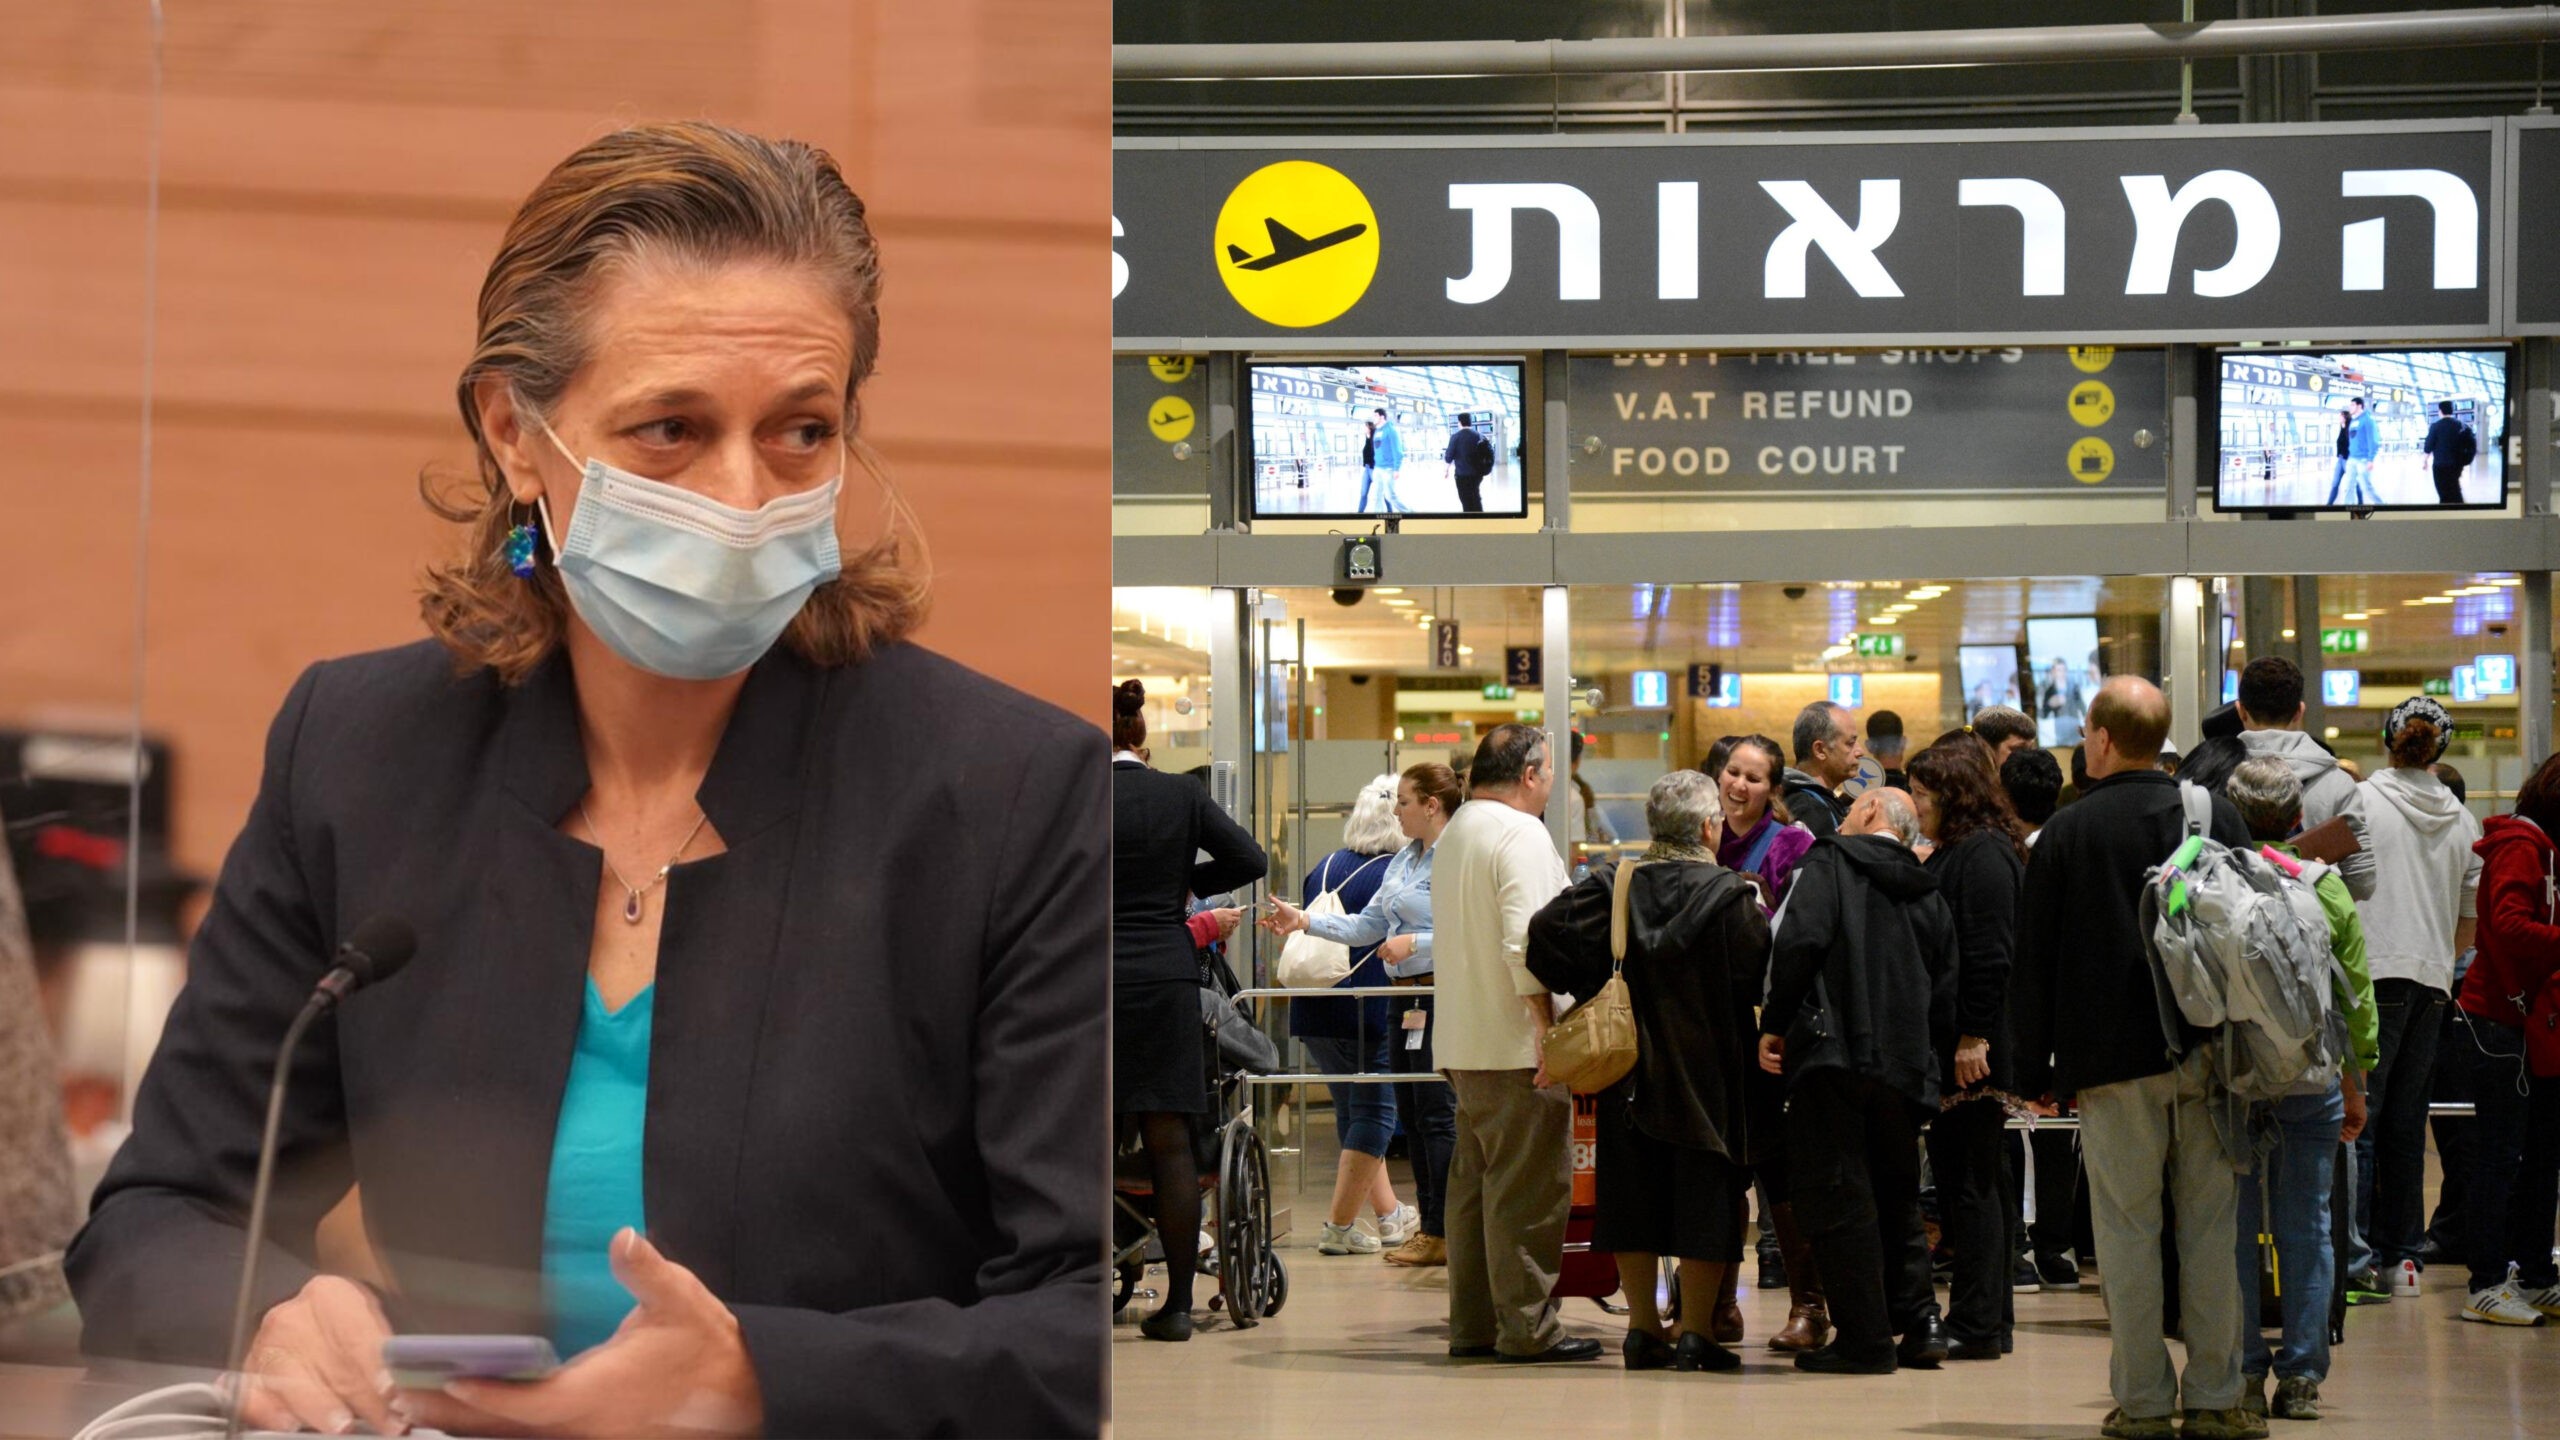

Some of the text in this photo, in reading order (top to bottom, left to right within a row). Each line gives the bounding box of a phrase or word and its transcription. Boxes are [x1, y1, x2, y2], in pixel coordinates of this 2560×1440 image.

[1446, 169, 2479, 305] המראות
[1613, 388, 1914, 421] V.A.T REFUND
[1612, 445, 1906, 476] FOOD COURT
